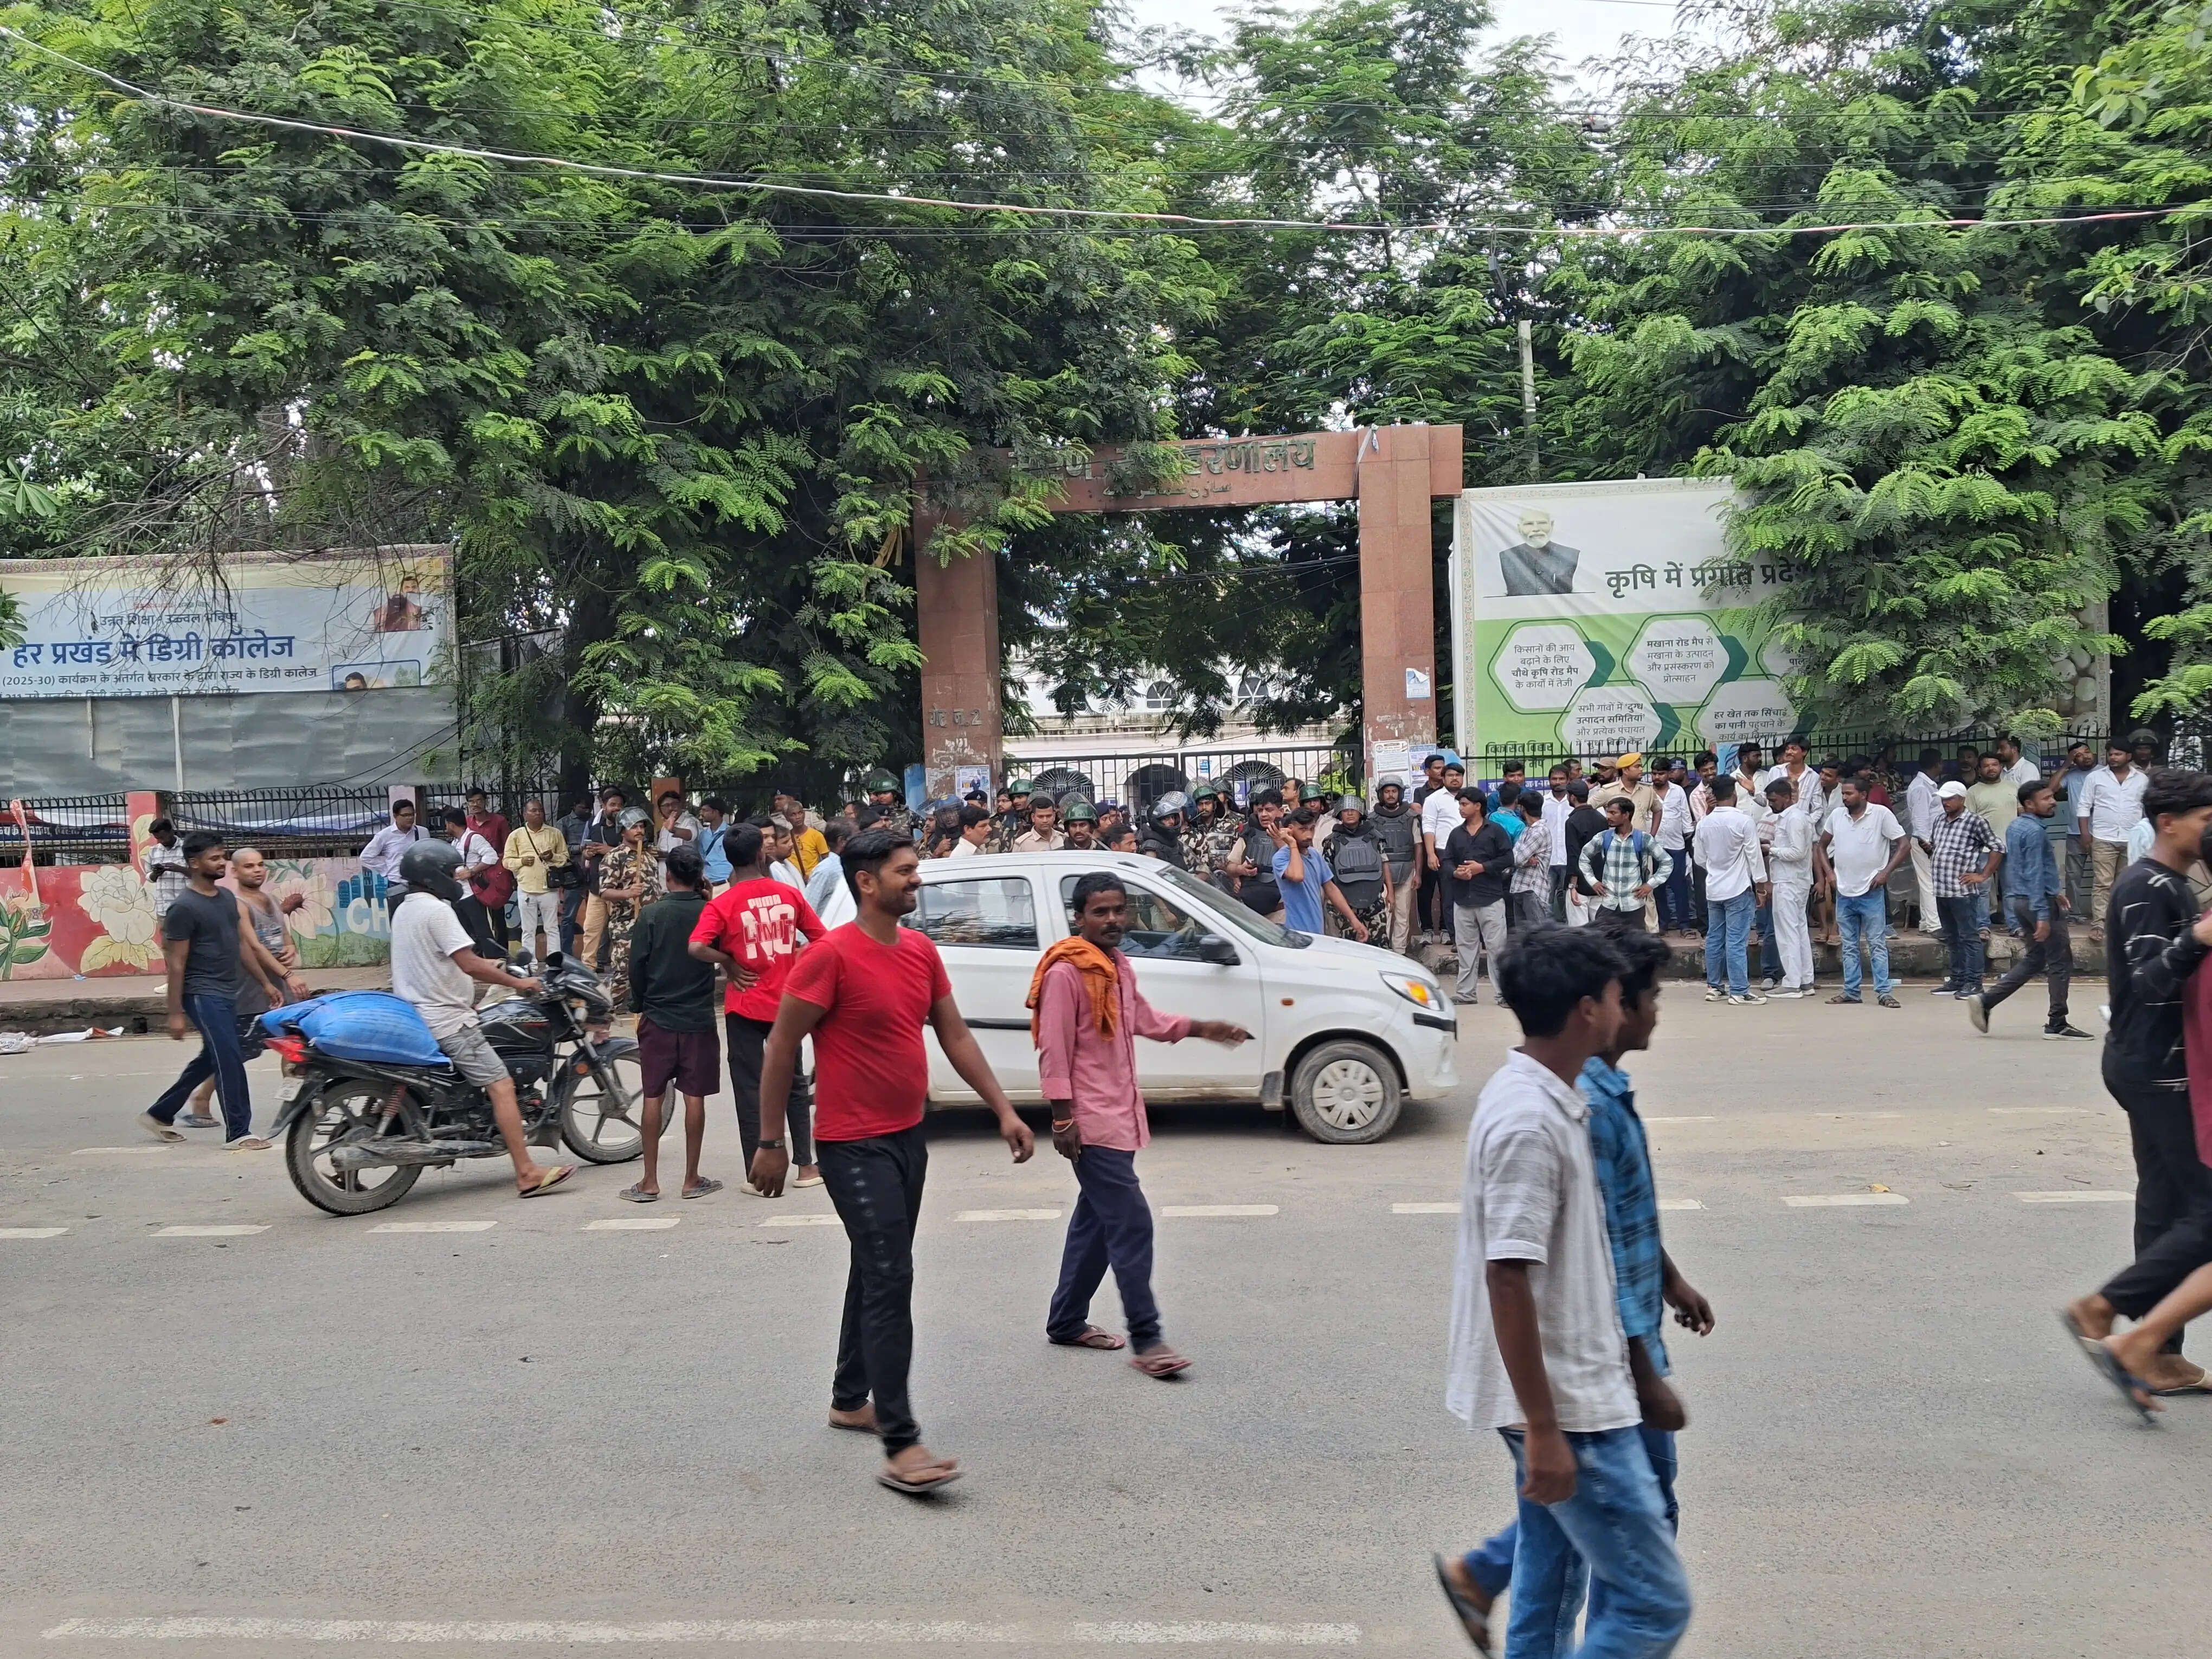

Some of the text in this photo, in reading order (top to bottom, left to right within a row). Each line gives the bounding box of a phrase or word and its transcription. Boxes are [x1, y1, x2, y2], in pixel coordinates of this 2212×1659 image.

[1605, 563, 1657, 599] कृषि
[1664, 561, 1683, 588] में
[1760, 556, 1806, 584] प्रदे
[127, 613, 156, 625] शिक्षा
[1676, 637, 1689, 646] रोड
[1691, 636, 1703, 646] मैप
[1705, 636, 1713, 646] से
[14, 643, 43, 668] हर
[51, 636, 112, 665] प्रखंड
[149, 632, 203, 662] डिग्री
[210, 628, 295, 660] कॉलेज
[1514, 643, 1543, 654] किसानों
[1546, 642, 1556, 652] की
[1543, 655, 1551, 664] के
[1554, 654, 1570, 664] लिए
[1647, 650, 1713, 660] मखाना के उत्पादन
[1511, 667, 1528, 677] चौथे
[1551, 666, 1564, 676] रोड
[1566, 665, 1579, 675] मैप
[1648, 662, 1661, 672] और
[1704, 660, 1714, 669] को
[3, 676, 55, 686] (2025-30)
[58, 672, 97, 684] कार्यक्रम
[100, 671, 110, 683] के
[183, 670, 194, 681] के
[221, 671, 243, 681] राज्य
[246, 667, 256, 679] के
[259, 667, 281, 679] डिग्री
[1663, 673, 1696, 683] प्रोत्साहन
[1515, 679, 1523, 689] के
[1557, 678, 1572, 687] तेजी
[1578, 703, 1594, 712] सभी
[970, 709, 982, 726] 2
[1727, 709, 1741, 718] खेत
[1576, 716, 1605, 724] उत्पादन
[1728, 719, 1746, 729] पानी
[1777, 718, 1786, 727] के
[1577, 726, 1591, 736] और
[1593, 726, 1615, 735] प्रत्येक
[1719, 731, 1736, 741] कार्य
[747, 893, 782, 910] PUMA
[740, 904, 795, 959] NO
[743, 919, 794, 944] LIMIT
